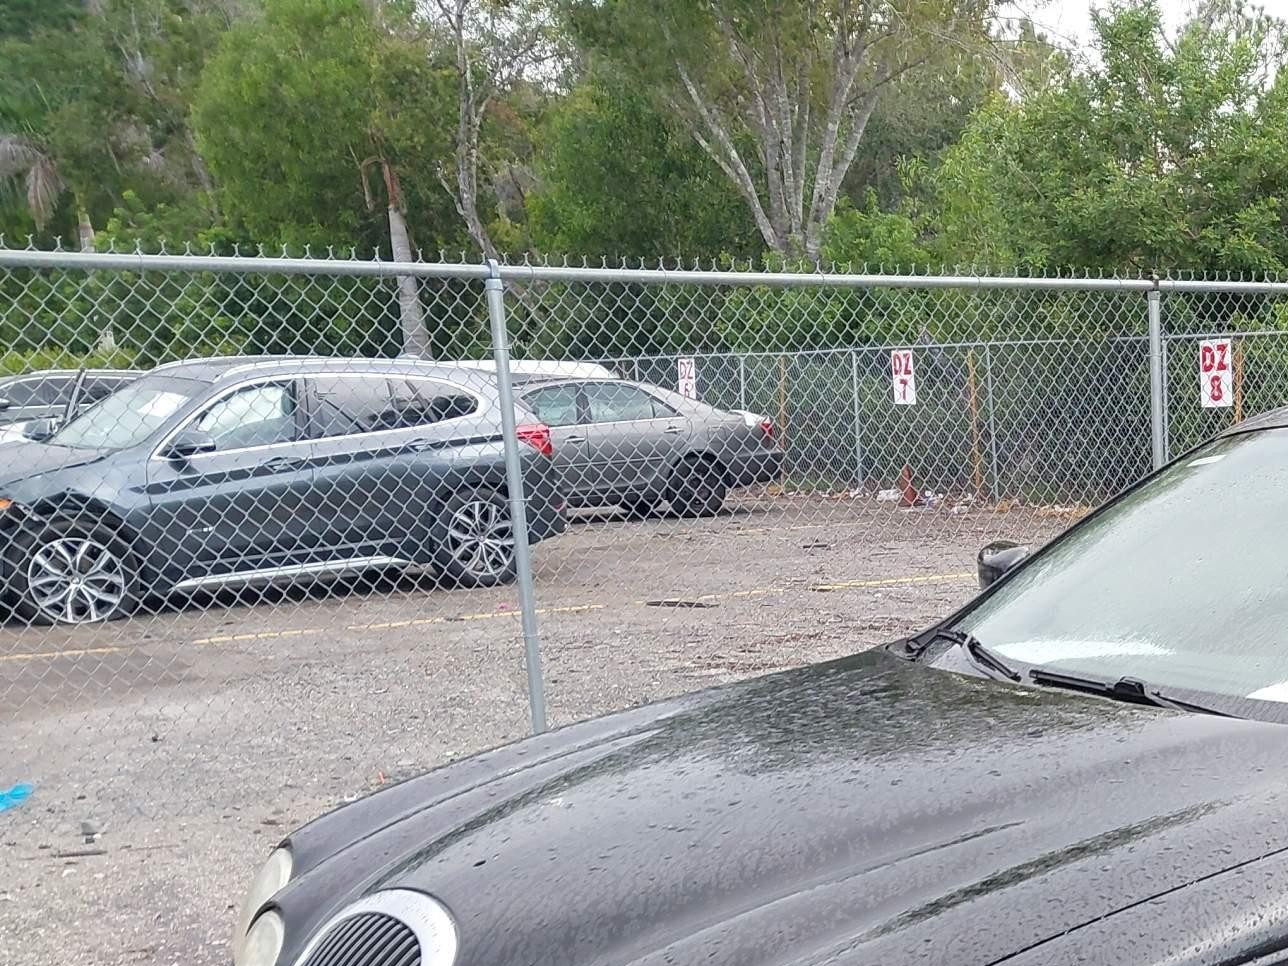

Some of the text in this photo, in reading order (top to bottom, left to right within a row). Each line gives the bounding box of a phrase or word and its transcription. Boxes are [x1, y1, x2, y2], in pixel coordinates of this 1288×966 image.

[893, 353, 912, 375] DZ
[1201, 344, 1228, 372] DZ
[1210, 375, 1222, 401] 8
